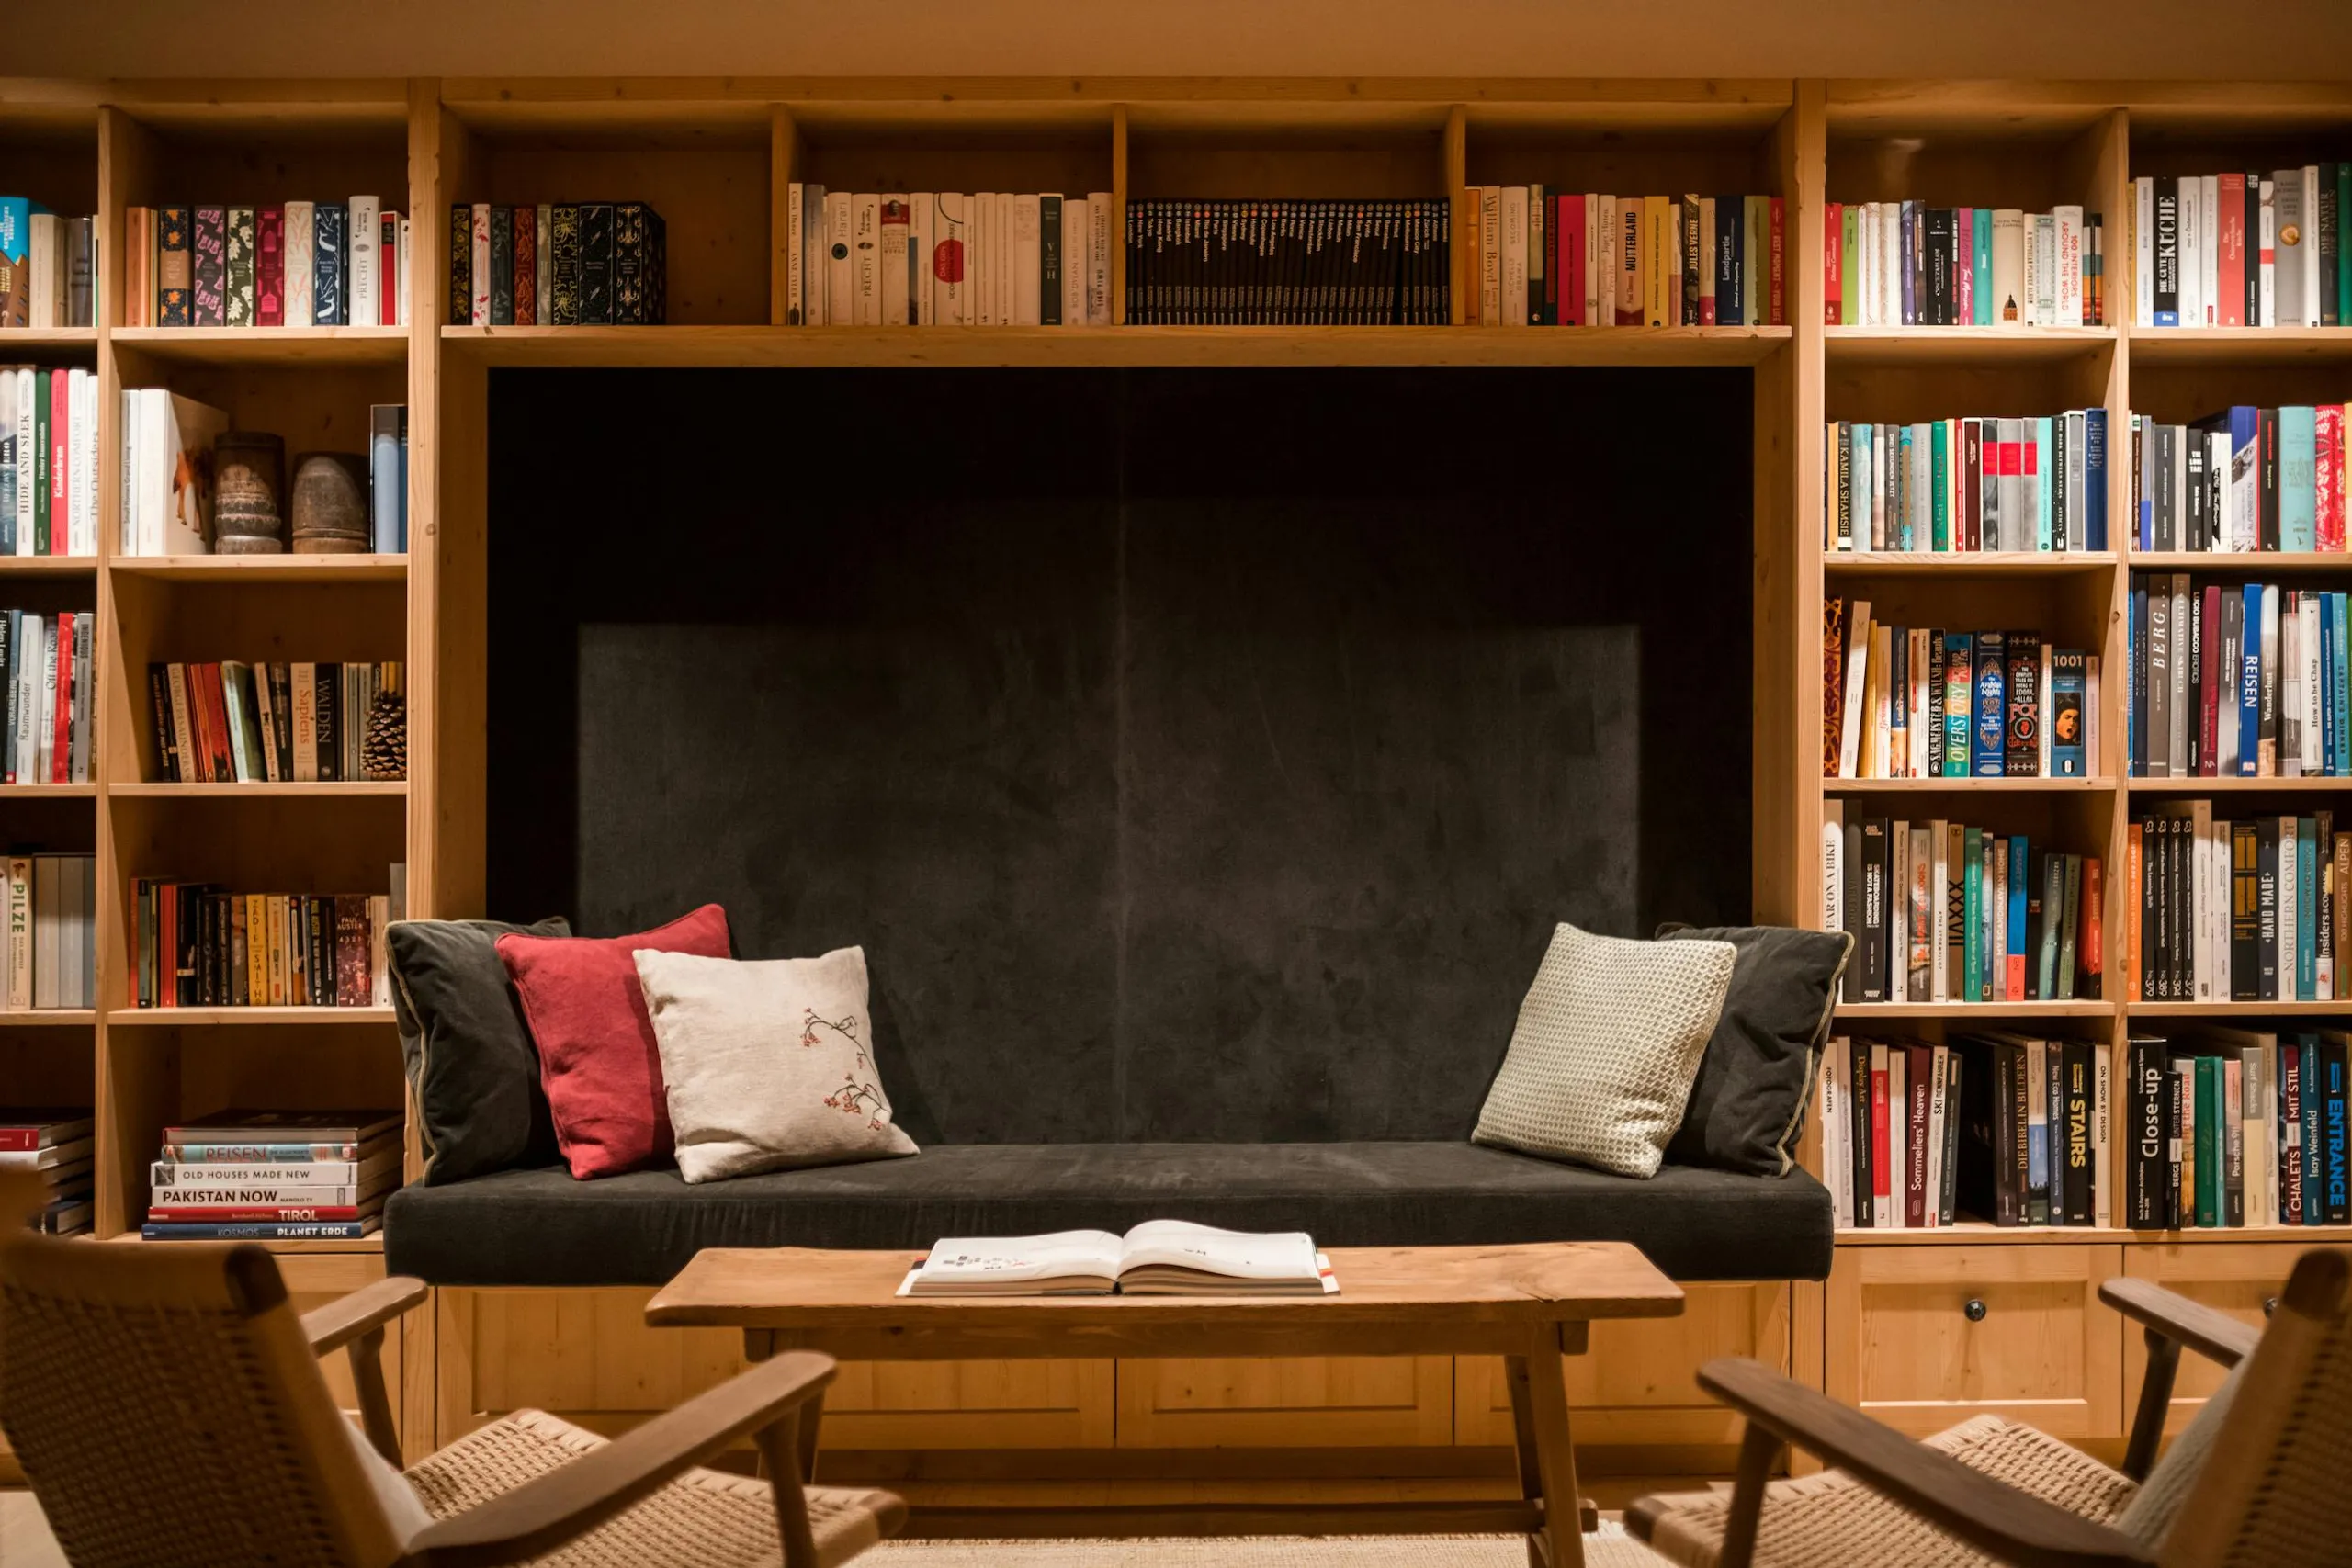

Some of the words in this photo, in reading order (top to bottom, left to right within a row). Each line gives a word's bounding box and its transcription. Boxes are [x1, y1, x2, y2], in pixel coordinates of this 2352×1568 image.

[837, 201, 848, 237] Harari
[1689, 219, 1698, 245] VERNE
[2158, 196, 2176, 257] KÜCHE
[1625, 211, 1636, 271] MUTTERLAND
[1689, 246, 1699, 271] JULES
[1722, 235, 1731, 280] Landpartie
[2061, 221, 2069, 260] AROUND
[2061, 262, 2069, 277] THE
[2070, 253, 2078, 298] INTERIORS
[2061, 280, 2069, 310] WORLD
[19, 414, 29, 446] SEEK
[19, 451, 29, 477] AND
[1840, 447, 1849, 490] KAMILA
[19, 482, 29, 513] HIDE
[1840, 491, 1849, 536] SHAMSIE
[2053, 655, 2083, 668] 1001
[2311, 659, 2319, 681] Chap
[2245, 655, 2258, 707] REISEN
[2264, 672, 2273, 722] Wanderlust
[2311, 683, 2318, 694] be
[19, 683, 31, 740] Raumwunder
[295, 690, 312, 744] Sapiens
[317, 679, 331, 743] WALDEN
[2311, 707, 2319, 728] How
[2312, 696, 2318, 705] to
[1930, 706, 1942, 761] SAGMEISTER
[1950, 684, 1967, 761] OVERSTORY
[2284, 822, 2295, 892] COMFORT
[2339, 838, 2349, 874] ALPEN
[12, 884, 25, 932] PILZE
[2262, 875, 2274, 905] MADE
[1949, 879, 1964, 946] XXXVII
[2262, 910, 2274, 938] HAND
[2284, 894, 2295, 972] NORTHERN
[2017, 1055, 2027, 1103] BILDERN
[2100, 1066, 2106, 1077] ON
[2288, 1066, 2298, 1091] STIL
[1913, 1085, 1925, 1123] Heaven
[1933, 1100, 1943, 1115] SKI
[2100, 1106, 2106, 1116] BY
[2142, 1067, 2162, 1158] Close-up
[2289, 1094, 2299, 1119] MIT
[2069, 1099, 2086, 1168] STAIRS
[2307, 1110, 2318, 1155] Weinfeld
[2232, 1140, 2241, 1177] Porsche
[2308, 1156, 2321, 1177] Isay
[2328, 1099, 2345, 1206] ENTRANCE
[183, 1170, 203, 1179] OLD
[208, 1170, 248, 1179] HOUSES
[253, 1170, 281, 1179] MADE
[286, 1170, 310, 1179] NEW
[2290, 1150, 2301, 1211] CHALETS
[163, 1190, 236, 1203] PAKISTAN
[240, 1190, 277, 1203] NOW
[277, 1227, 317, 1236] PLANET
[321, 1226, 348, 1236] ERDE
[278, 1209, 319, 1222] TIROL
